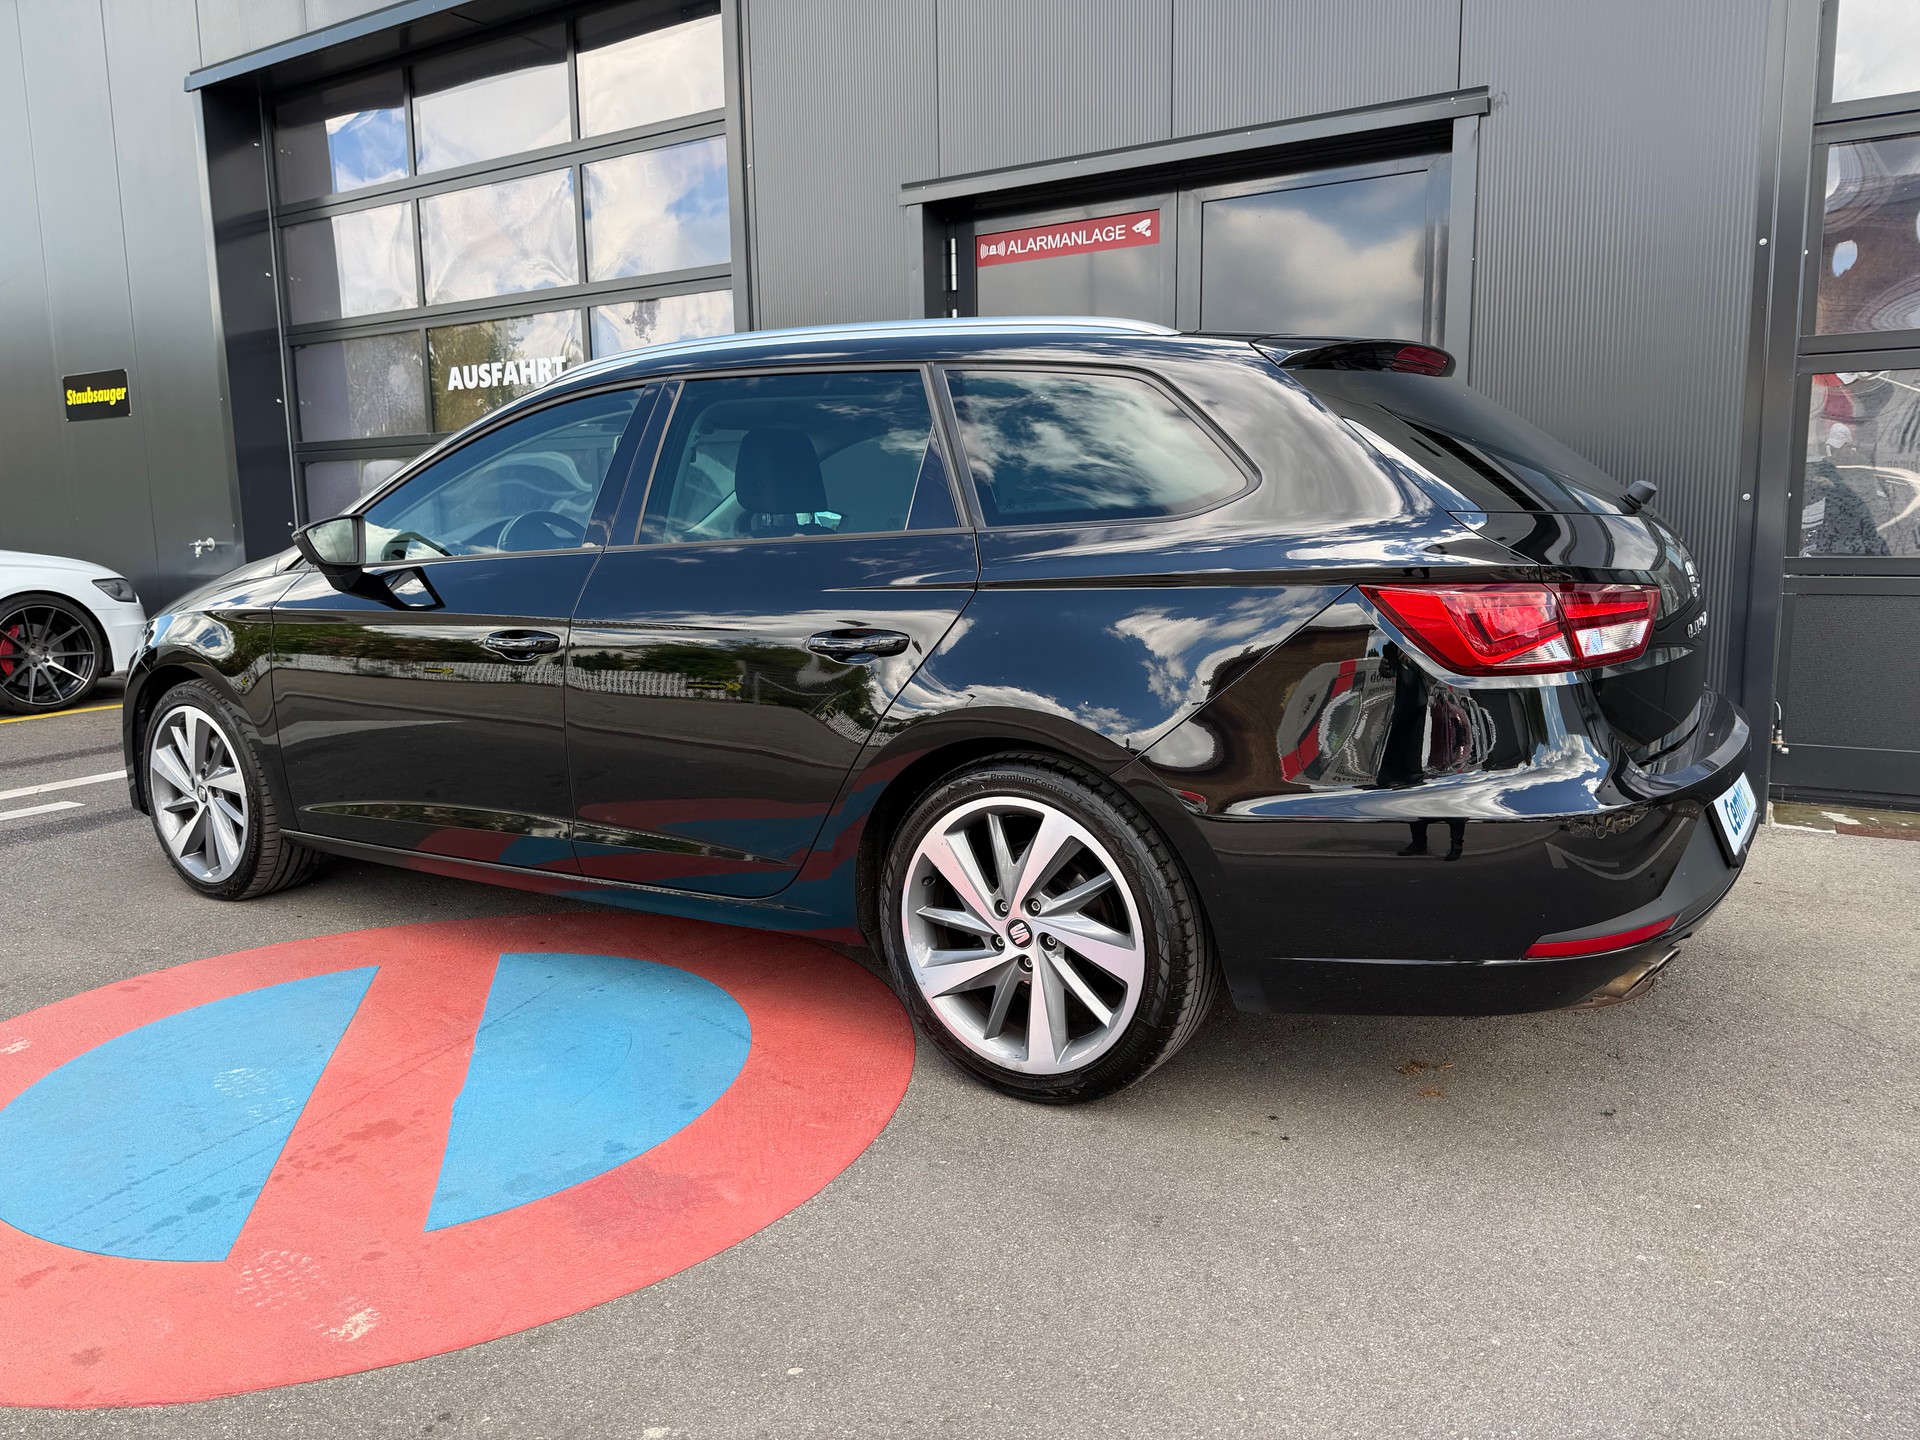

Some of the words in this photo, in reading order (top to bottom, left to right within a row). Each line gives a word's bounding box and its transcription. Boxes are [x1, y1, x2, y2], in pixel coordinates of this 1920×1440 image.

[1006, 224, 1127, 256] ALARMANLAGE
[447, 355, 567, 391] AUSFAHRT
[66, 386, 127, 406] Staubsauger
